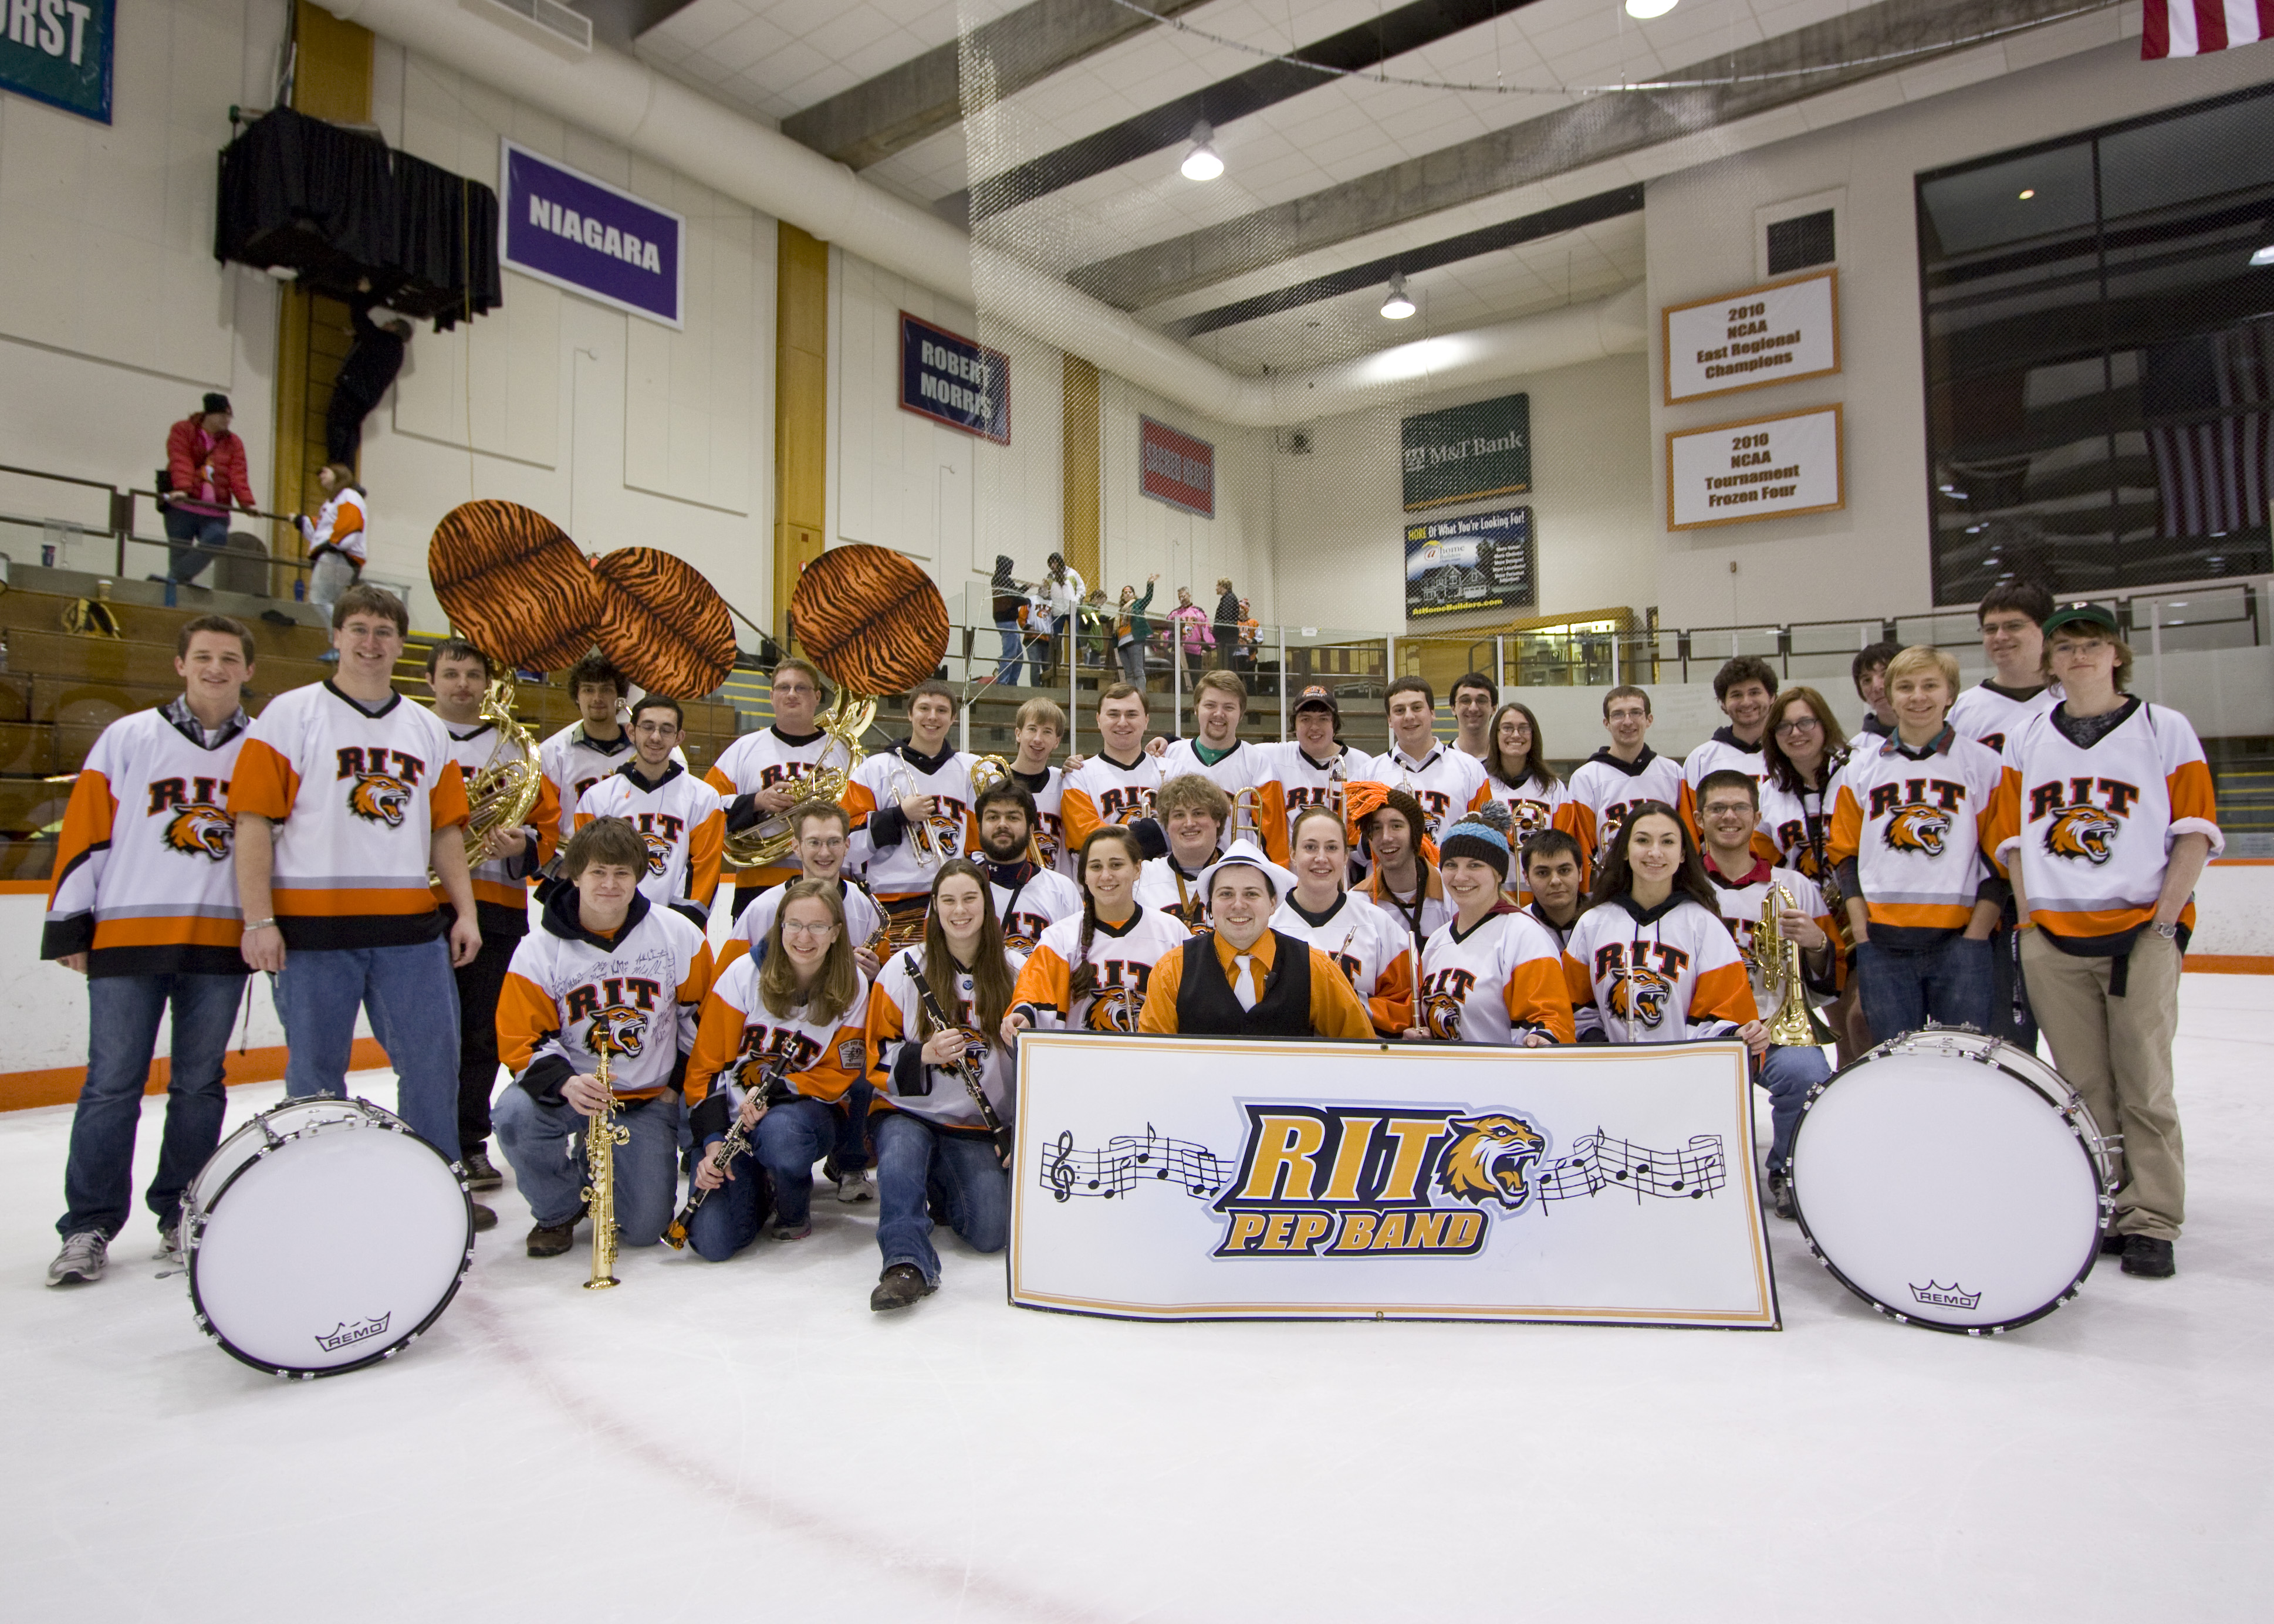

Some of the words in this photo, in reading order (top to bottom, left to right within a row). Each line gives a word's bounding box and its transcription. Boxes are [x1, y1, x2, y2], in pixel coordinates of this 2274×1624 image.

[0, 0, 91, 66] RST
[529, 193, 661, 275] NIAGARA
[1728, 302, 1765, 322] 2010
[1727, 320, 1768, 339] NCAA
[1697, 346, 1728, 363] East
[1731, 330, 1800, 356] Regional
[1705, 351, 1793, 379] Champions
[1430, 440, 1470, 464] M&T
[1474, 430, 1523, 456] Bank
[1732, 432, 1769, 451] 2010
[1731, 450, 1772, 468] NCAA
[1705, 465, 1800, 490] Tournament
[1708, 490, 1759, 508] Frozen
[1762, 485, 1797, 500] Four
[1438, 523, 1457, 536] What
[1458, 520, 1479, 533] You're
[1481, 516, 1508, 529] Looking
[1510, 511, 1525, 525] For!
[1413, 599, 1503, 615] AtHomeBuilders.com
[337, 746, 425, 787] RIT
[148, 776, 230, 817] RI
[1869, 778, 1966, 821] RIT
[2029, 777, 2140, 824] RIT
[1595, 940, 1690, 985] RIT
[565, 977, 661, 1027] RIT
[1235, 1115, 1449, 1202] RIT
[1223, 1212, 1329, 1250] PEP
[1332, 1211, 1484, 1250] BAND
[1920, 1291, 1972, 1306] REMO
[328, 1322, 382, 1348] REMO
